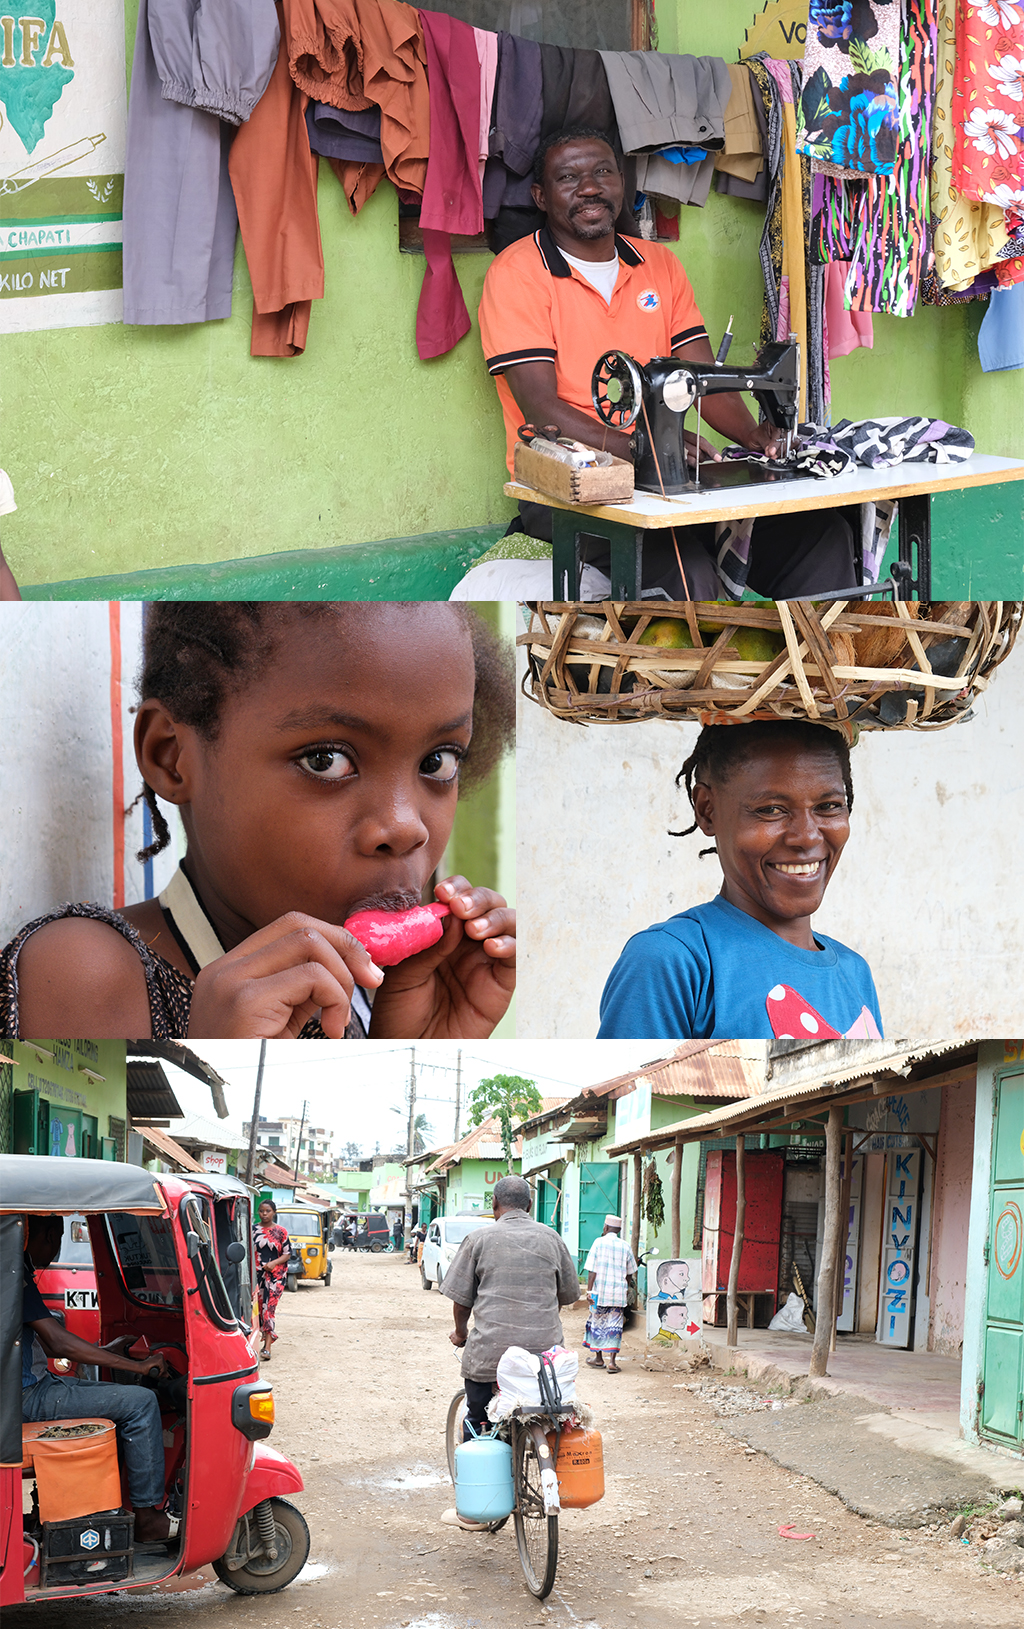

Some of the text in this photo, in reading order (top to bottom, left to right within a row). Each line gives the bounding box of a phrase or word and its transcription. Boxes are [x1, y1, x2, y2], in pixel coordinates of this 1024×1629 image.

[1, 17, 75, 68] IFA
[8, 229, 71, 248] CHAPATI
[0, 267, 71, 292] KILO NET
[52, 1044, 75, 1073] HAMZA
[205, 1155, 225, 1168] shop
[885, 1153, 914, 1337] KINYOZI
